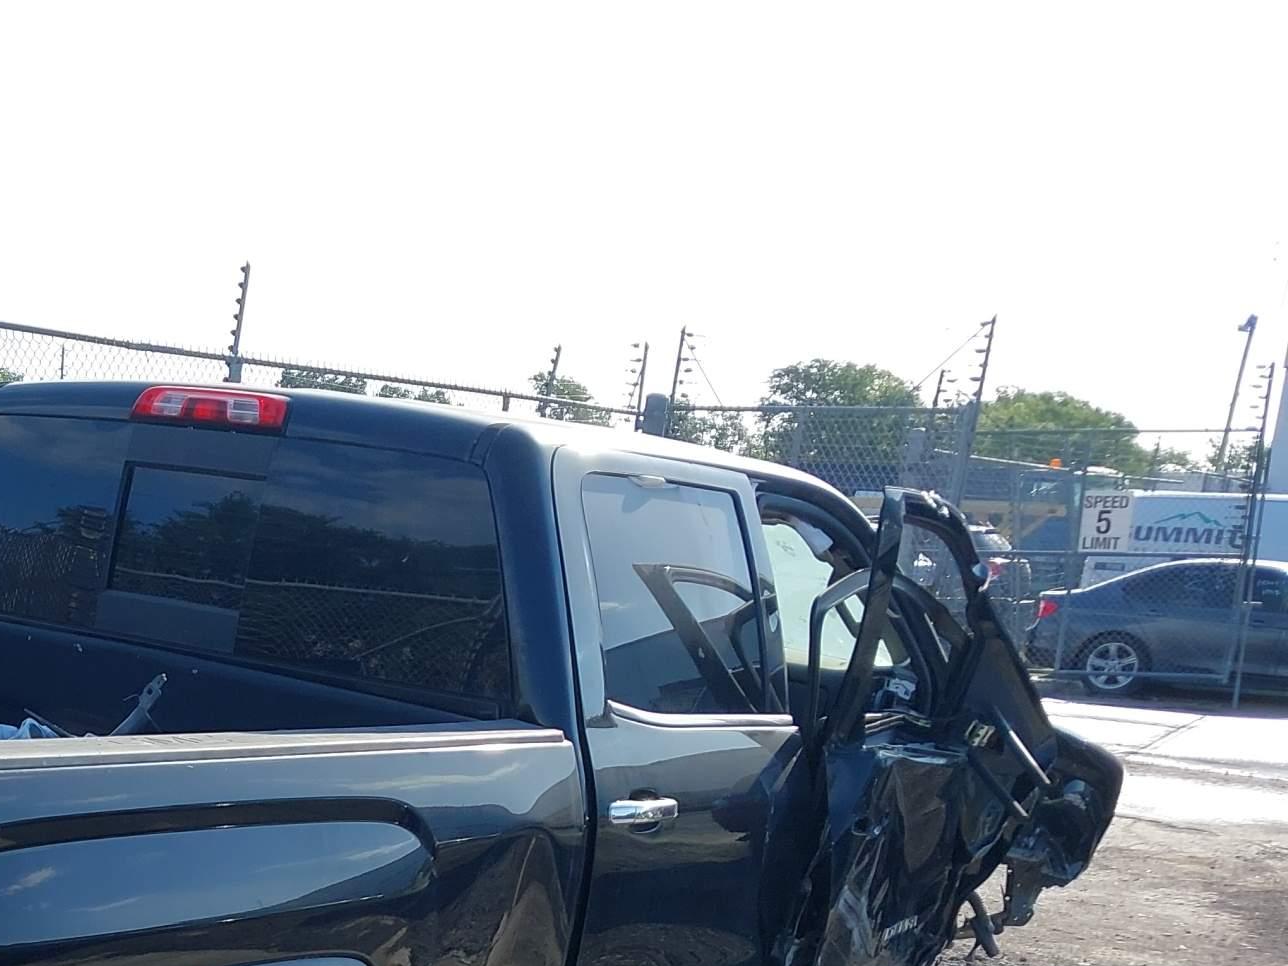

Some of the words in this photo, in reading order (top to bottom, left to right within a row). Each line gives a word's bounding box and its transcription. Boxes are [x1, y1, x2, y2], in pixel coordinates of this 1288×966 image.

[1084, 495, 1129, 509] SPEED
[1096, 510, 1112, 534] 5
[1082, 536, 1120, 550] LIMIT
[1128, 525, 1244, 548] UMMIT
